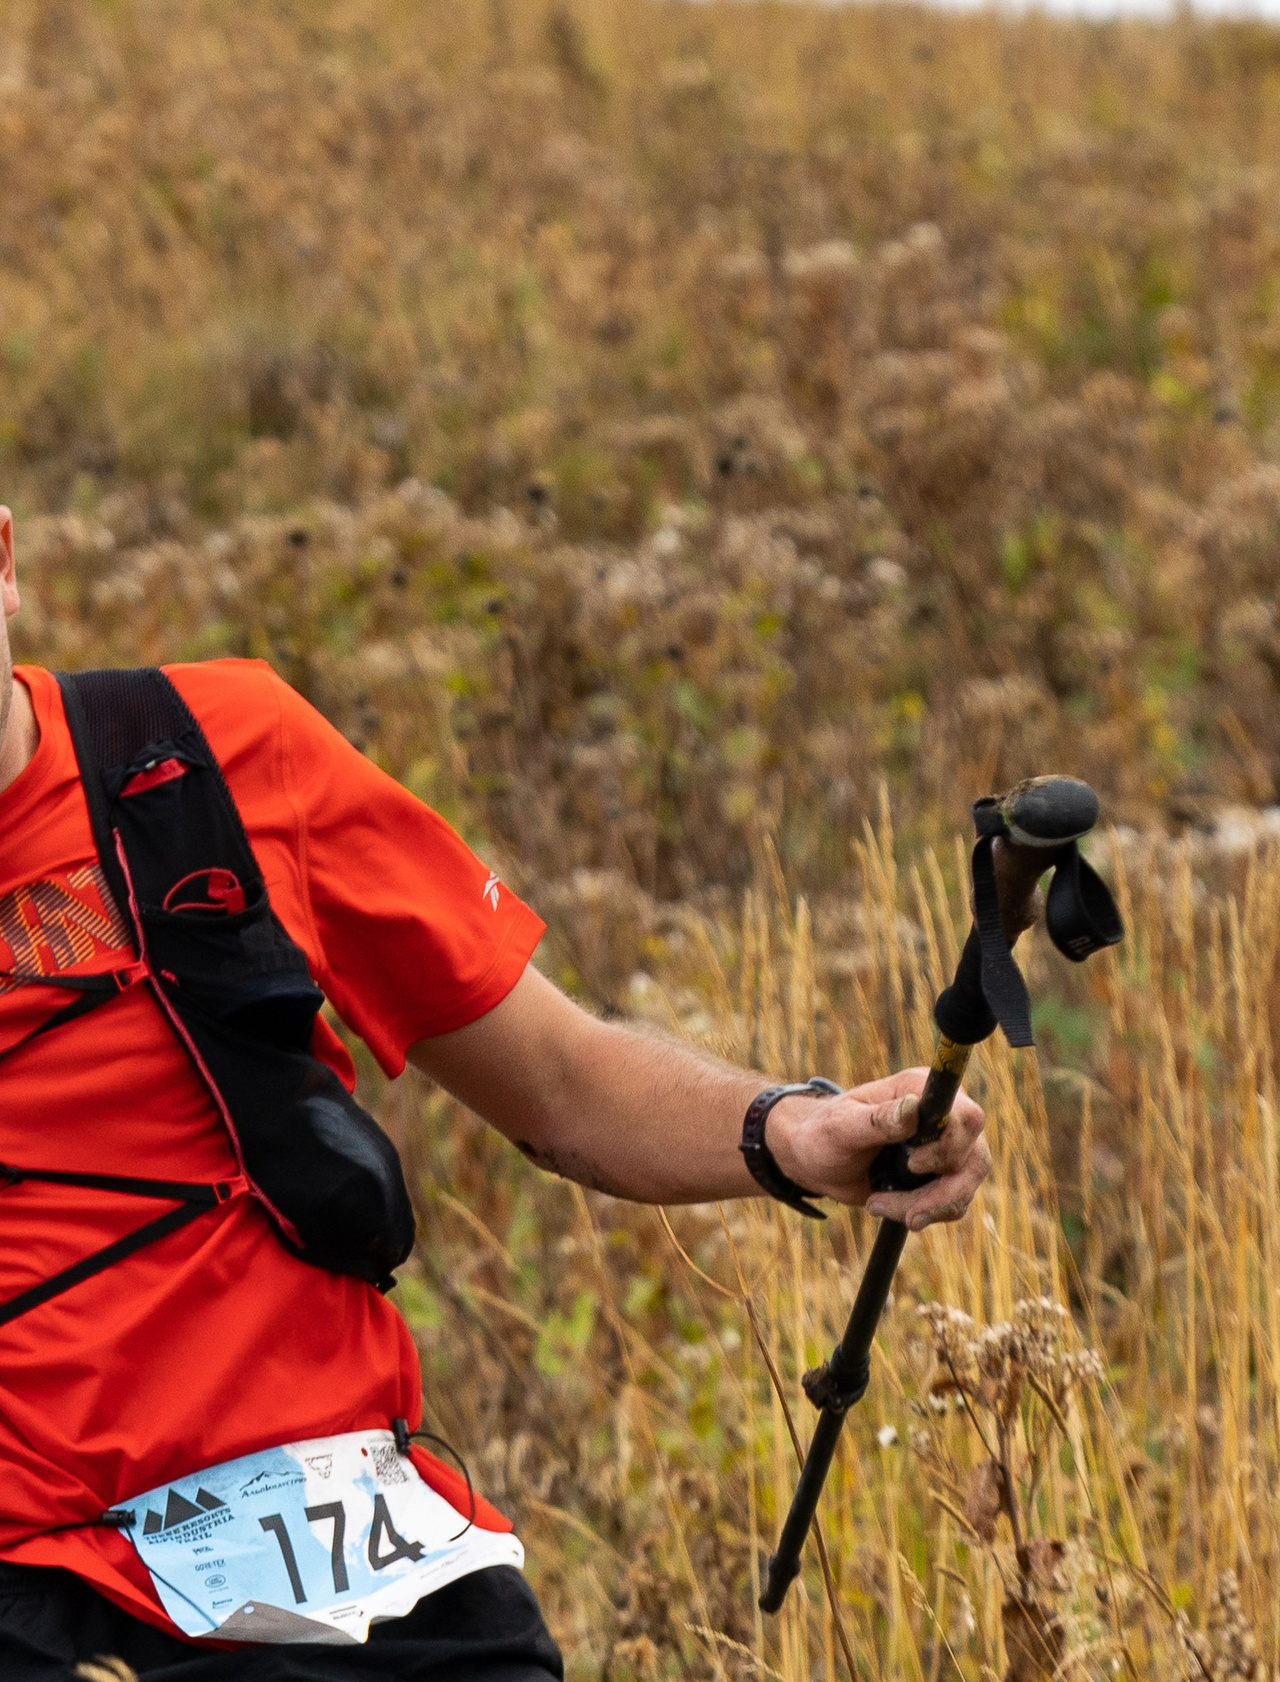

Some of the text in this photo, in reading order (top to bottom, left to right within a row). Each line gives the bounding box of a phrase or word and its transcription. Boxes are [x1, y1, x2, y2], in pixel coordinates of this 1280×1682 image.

[144, 1506, 231, 1541] THREE RESORTS
[148, 1513, 235, 1545] ALPINDUSTRIA
[176, 1531, 212, 1544] TRAIL
[258, 1493, 426, 1604] 174
